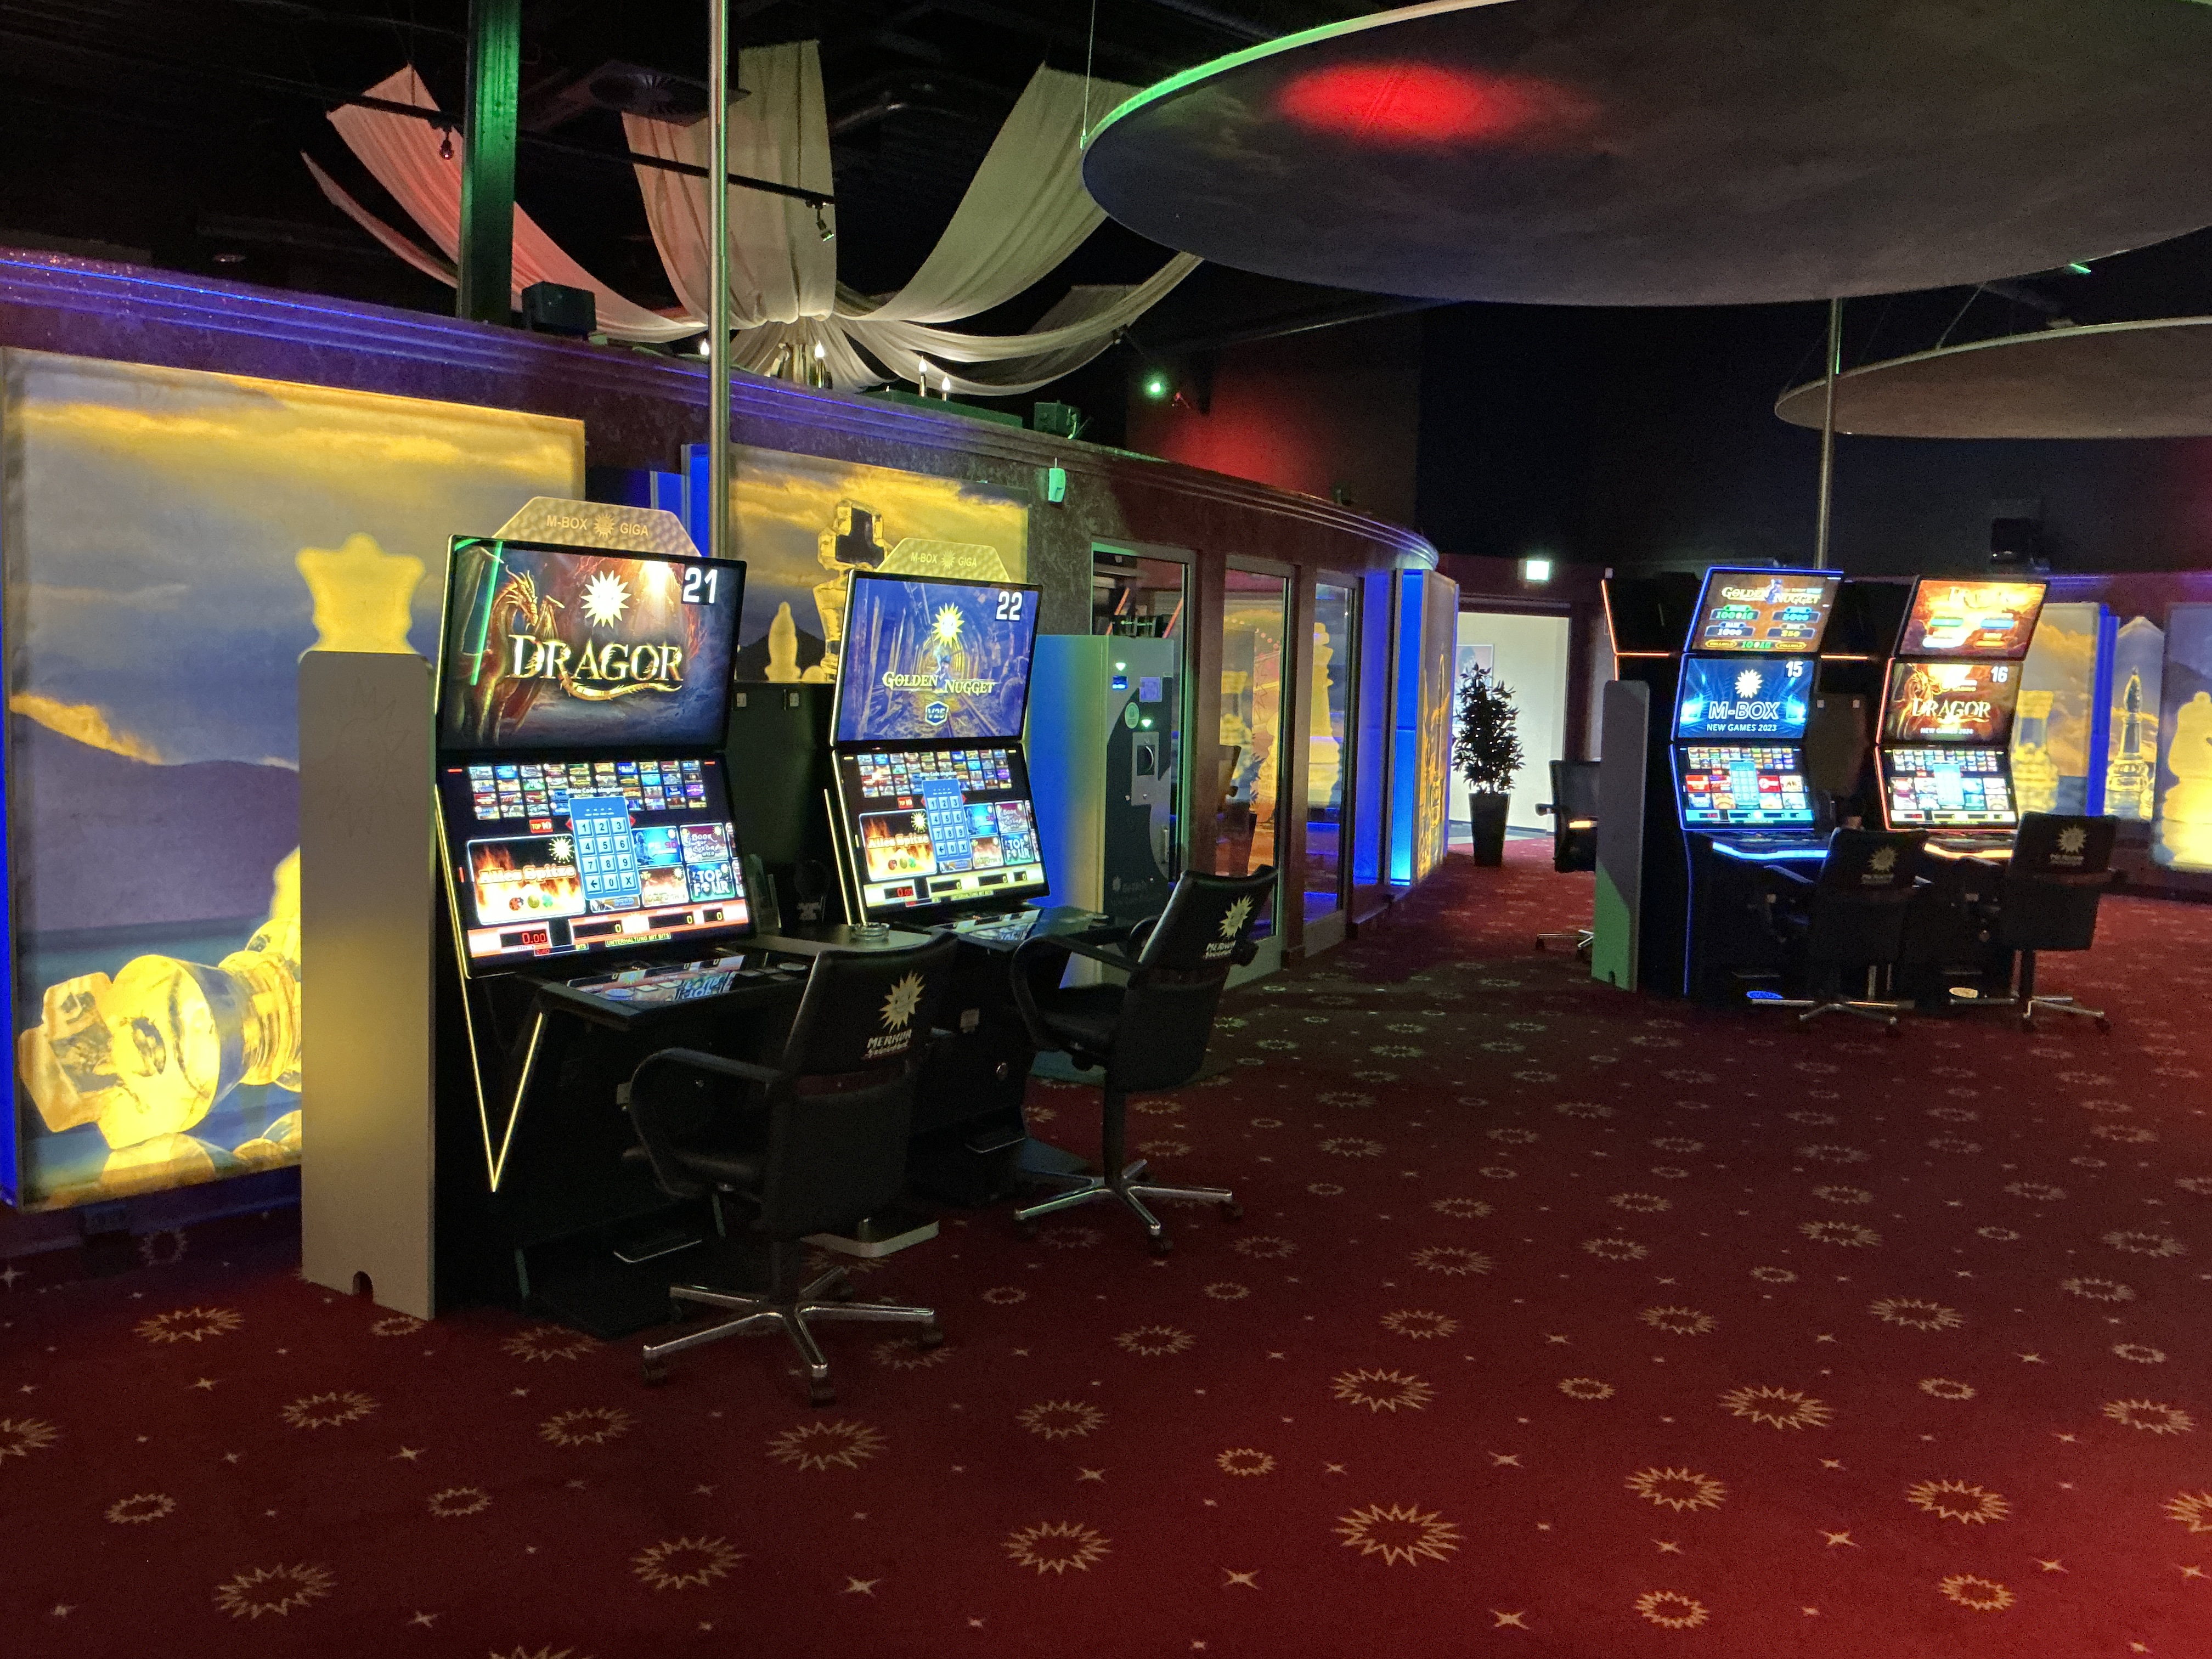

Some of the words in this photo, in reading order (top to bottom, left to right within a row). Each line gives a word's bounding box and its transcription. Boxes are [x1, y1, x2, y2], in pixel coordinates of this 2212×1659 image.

[546, 514, 588, 531] M-BOX
[620, 523, 650, 537] GIGA
[910, 552, 938, 564] M-BOX
[958, 557, 977, 567] GIGA
[682, 567, 718, 603] 21
[1722, 586, 1769, 599] GOLDEN
[996, 591, 1023, 620] 22
[505, 634, 684, 692] DRAGOR
[1785, 661, 1803, 678] 15
[882, 671, 938, 690] GOLDEN
[1990, 666, 2008, 682] 16
[944, 680, 997, 696] NUGGET
[927, 707, 946, 719] V25
[1708, 701, 1781, 720] M-BOX
[1911, 697, 1991, 720] DRAGOR
[868, 835, 895, 849] Alles
[895, 832, 929, 847] Spitze
[623, 859, 628, 867] 9
[479, 868, 522, 884] Alles
[523, 864, 576, 883] Spitze
[609, 878, 614, 887] 0
[625, 877, 632, 885] X
[697, 870, 723, 882] TOP
[694, 881, 730, 896] FOUR
[687, 916, 693, 924] 0
[716, 912, 723, 921] 0
[614, 924, 622, 933] 0
[522, 933, 546, 944] 0.00
[607, 935, 647, 946] UNTERHALTUNG
[867, 1029, 912, 1049] MERKUR
